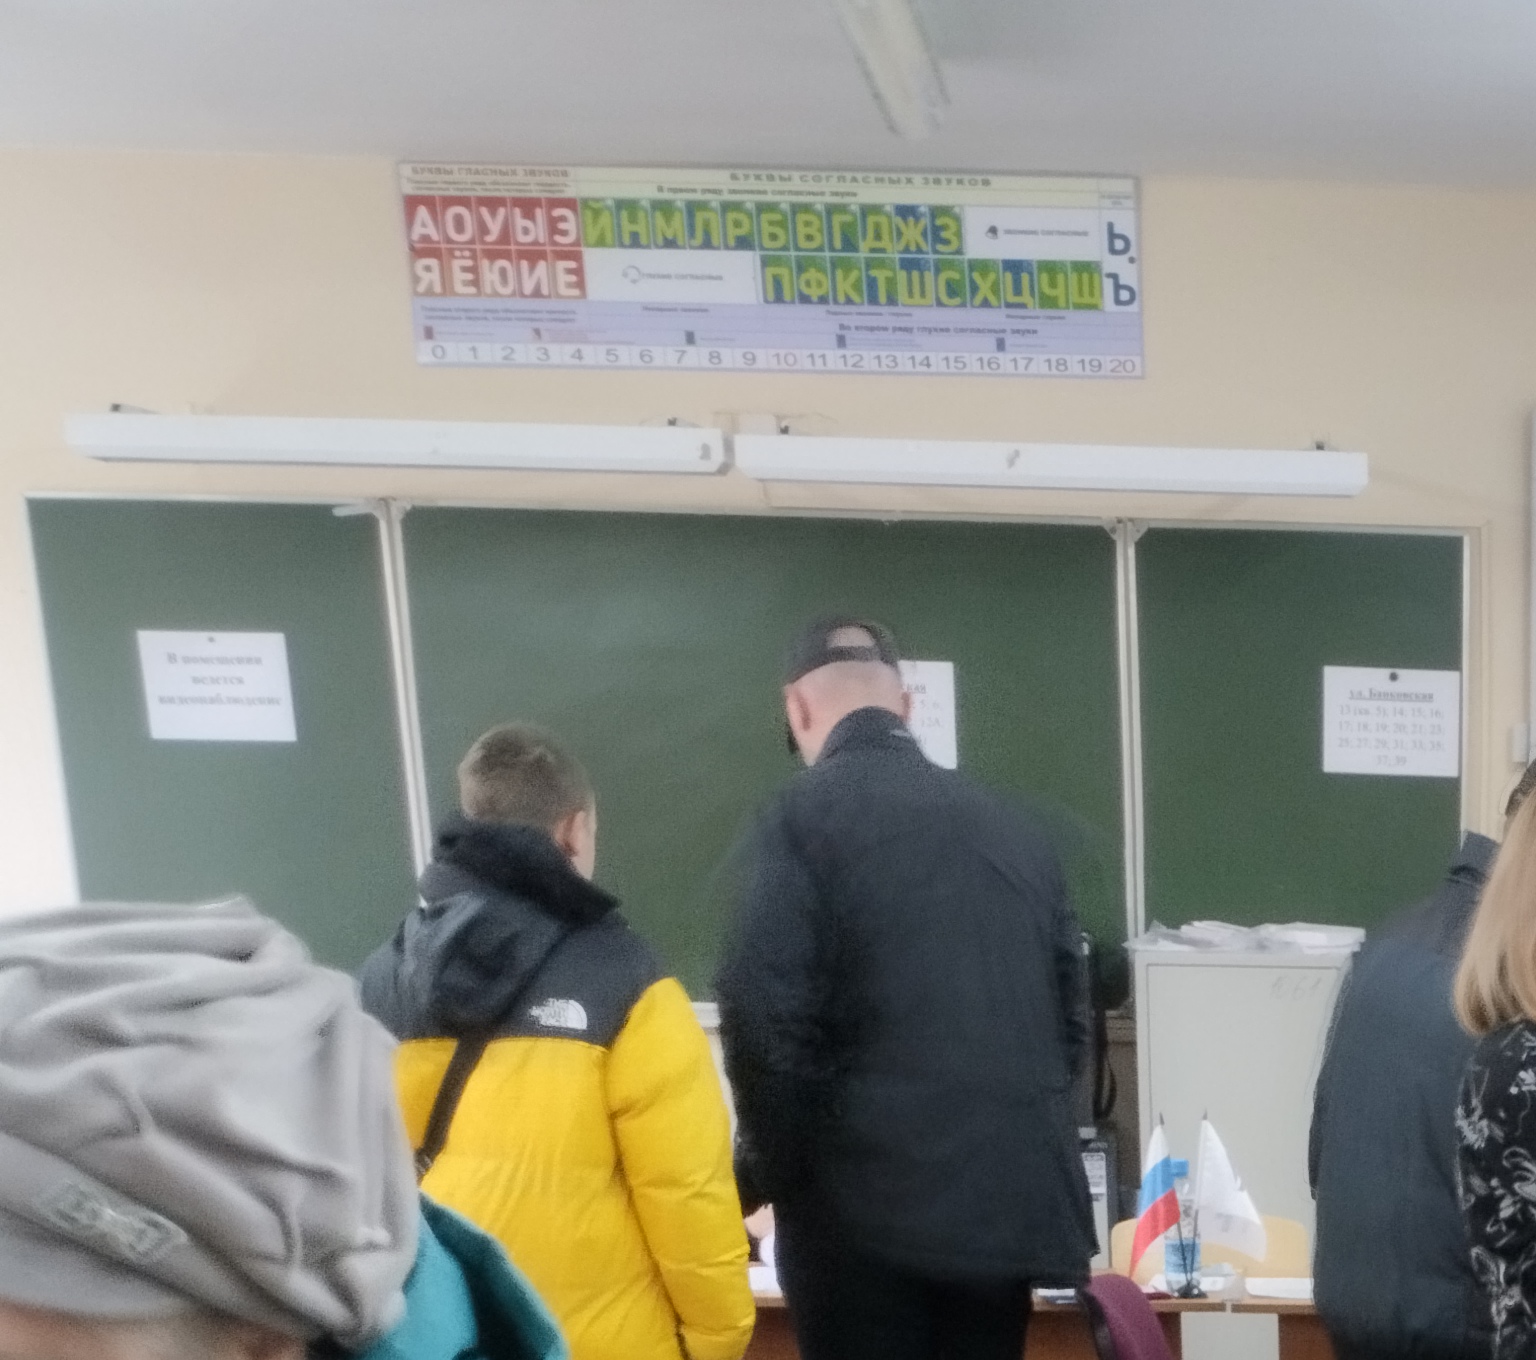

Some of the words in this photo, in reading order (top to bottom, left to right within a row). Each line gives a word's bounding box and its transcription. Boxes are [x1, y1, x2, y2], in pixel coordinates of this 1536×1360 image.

[730, 172, 792, 182] БУКВЫ
[799, 174, 914, 185] СОГЛАСНЫХ
[921, 176, 991, 187] ЗВУКОВ
[430, 344, 446, 361] 0
[469, 345, 478, 361] 1
[501, 345, 516, 362] 2
[536, 347, 551, 362] 3
[570, 348, 584, 363] 4
[605, 349, 620, 364] 5
[639, 349, 654, 365] 6
[674, 350, 687, 365] 7
[708, 350, 722, 366] 8
[742, 351, 756, 366] 9
[771, 352, 797, 368] 10
[807, 353, 827, 369] 11
[840, 353, 864, 369] 12
[874, 354, 898, 370] 13
[907, 354, 932, 370] 14
[942, 355, 967, 371] 15
[976, 355, 1001, 371] 16
[1011, 356, 1034, 372] 17
[1044, 356, 1069, 373] 18
[1077, 357, 1102, 373] 19
[1109, 358, 1136, 374] 20
